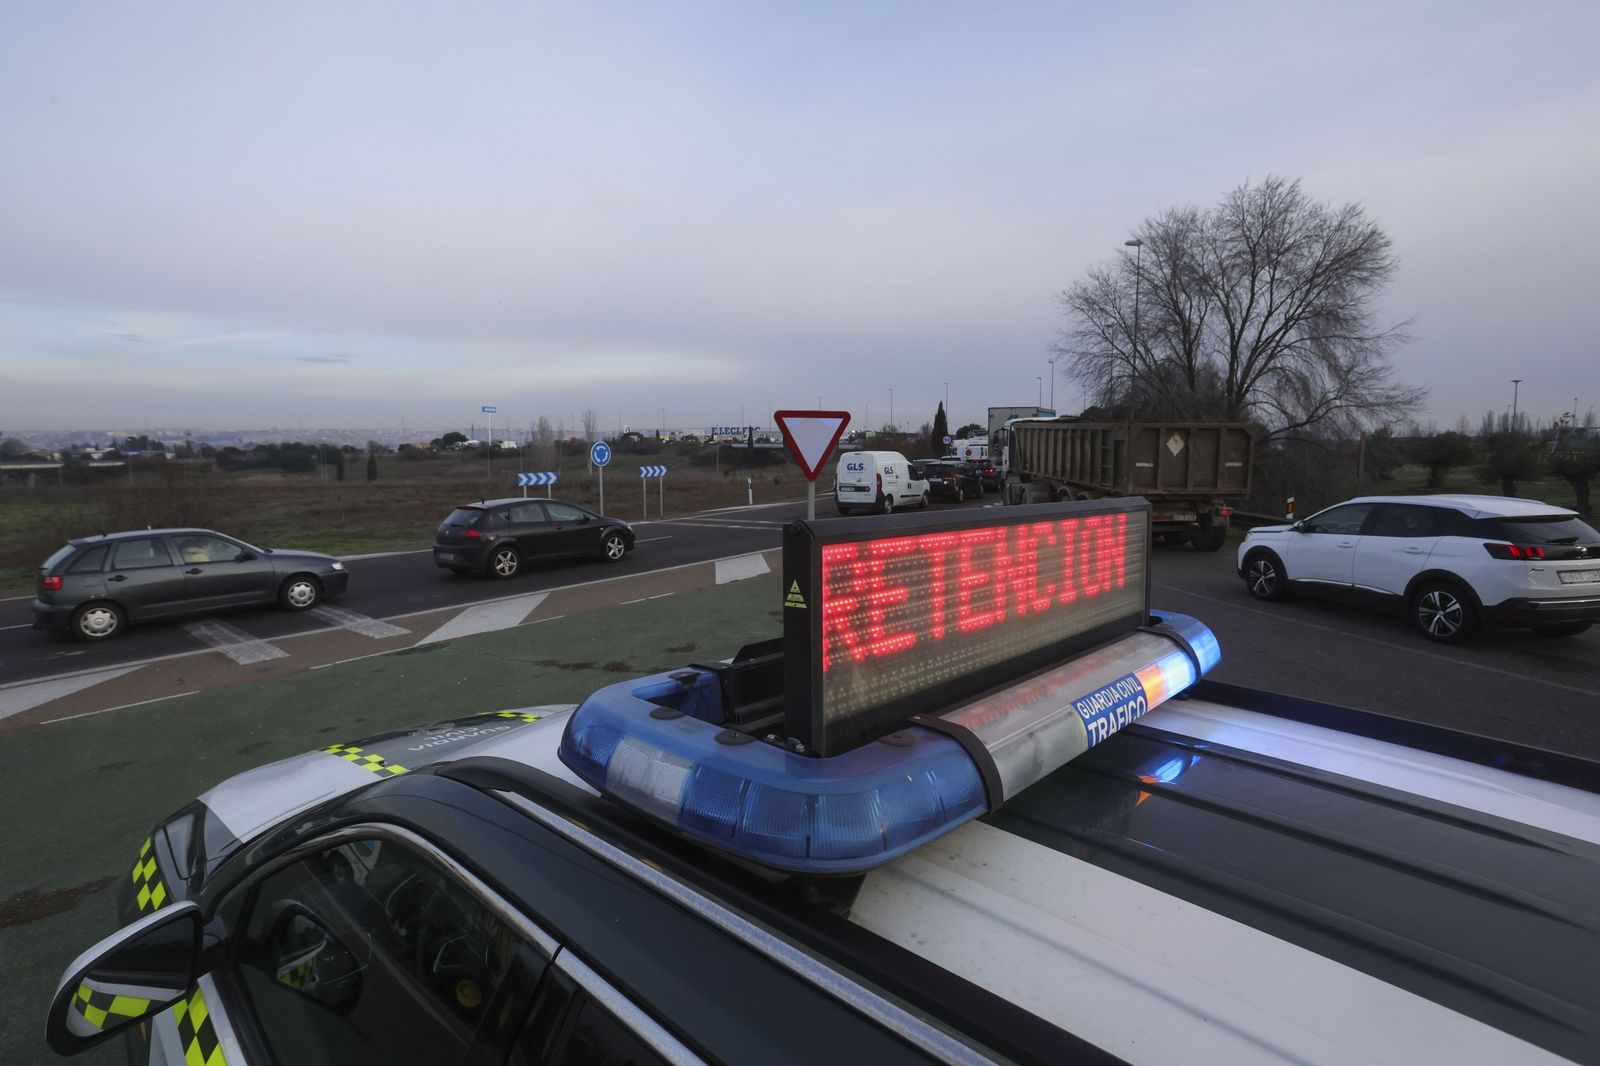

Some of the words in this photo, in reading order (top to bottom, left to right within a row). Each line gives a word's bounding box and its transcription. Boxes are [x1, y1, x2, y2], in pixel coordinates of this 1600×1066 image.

[846, 462, 864, 471] GLS
[884, 466, 894, 475] GLS
[822, 512, 1127, 673] RETENCION
[1076, 686, 1122, 719] GUARDIA
[1116, 676, 1142, 698] CIVIL
[423, 727, 479, 741] CIVIL
[1087, 695, 1146, 747] TRAFICO
[408, 725, 511, 751] GUARDIA
